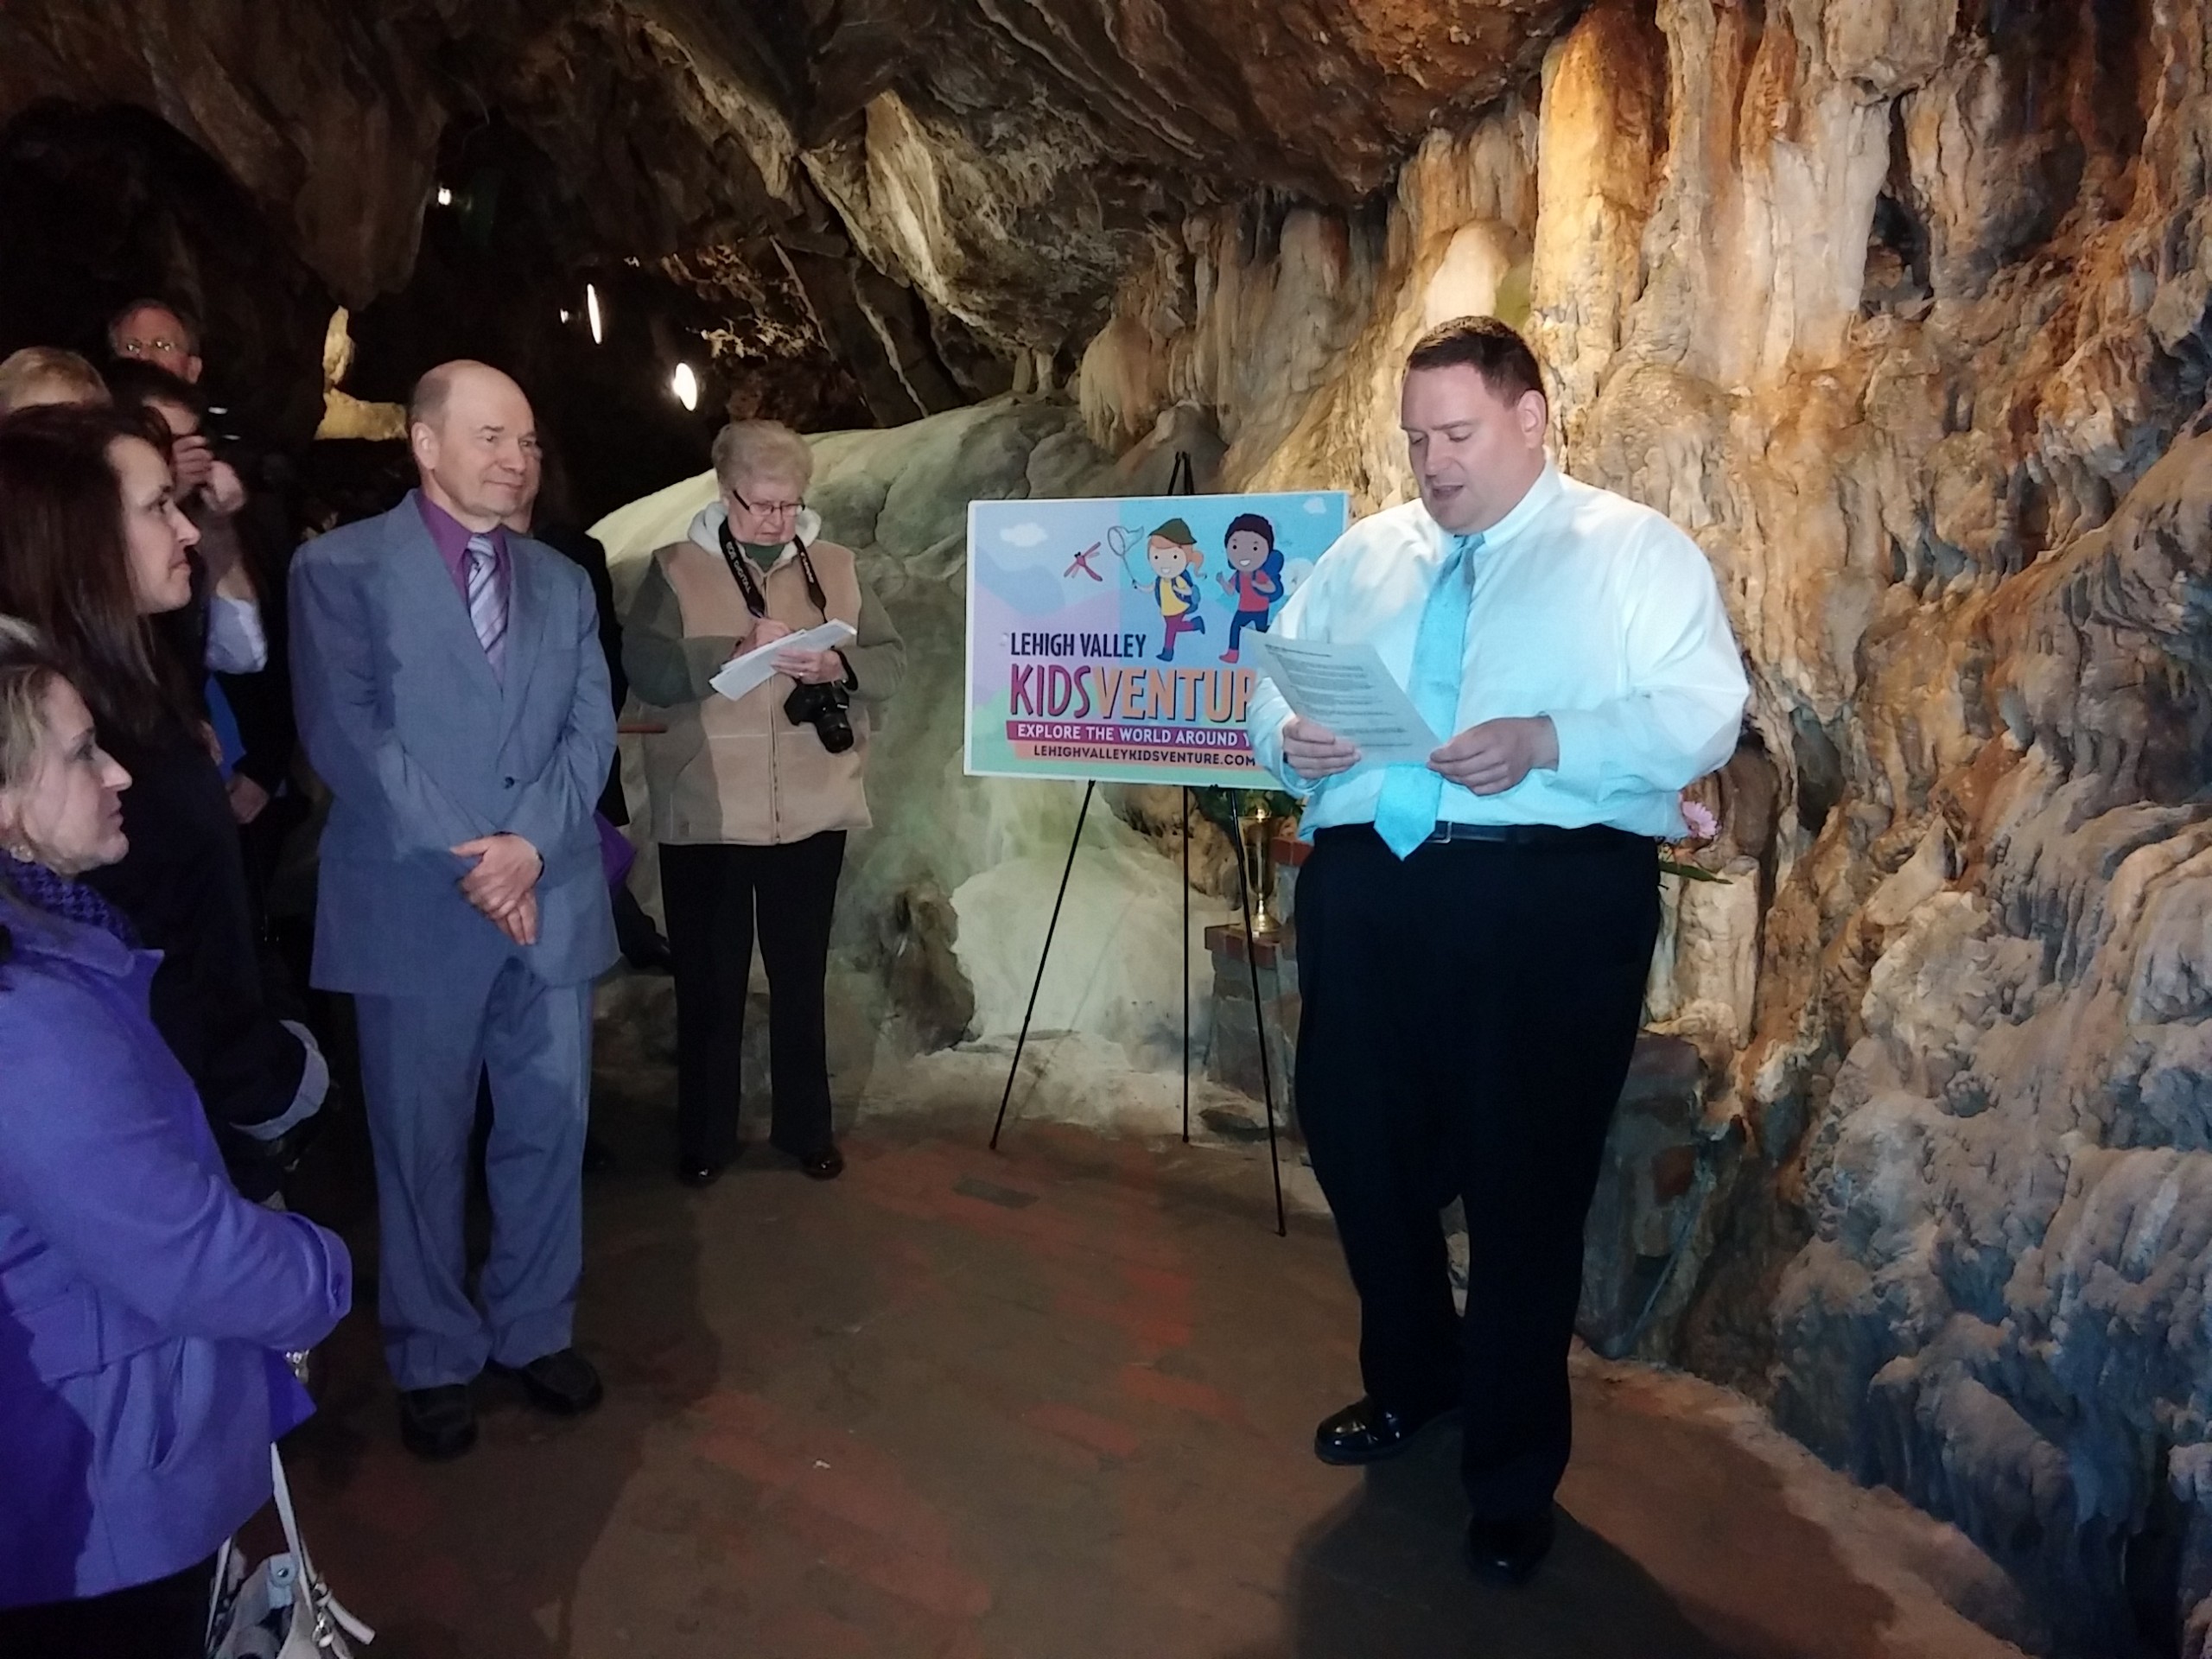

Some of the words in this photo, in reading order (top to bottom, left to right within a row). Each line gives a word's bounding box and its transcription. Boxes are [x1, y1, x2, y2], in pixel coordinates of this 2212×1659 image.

[734, 560, 751, 594] DIGITAL
[1011, 632, 1074, 657] LEHIGH
[1080, 633, 1147, 658] VALLEY
[1010, 664, 1258, 723] KIDSVENTUR
[1018, 723, 1081, 740] EXPLORE
[1086, 727, 1115, 741] THE
[1120, 728, 1171, 744] WORLD
[1175, 730, 1237, 747] AROUND
[1034, 745, 1256, 766] LEHIGHVALLEYKIDSVENTURE.COM
